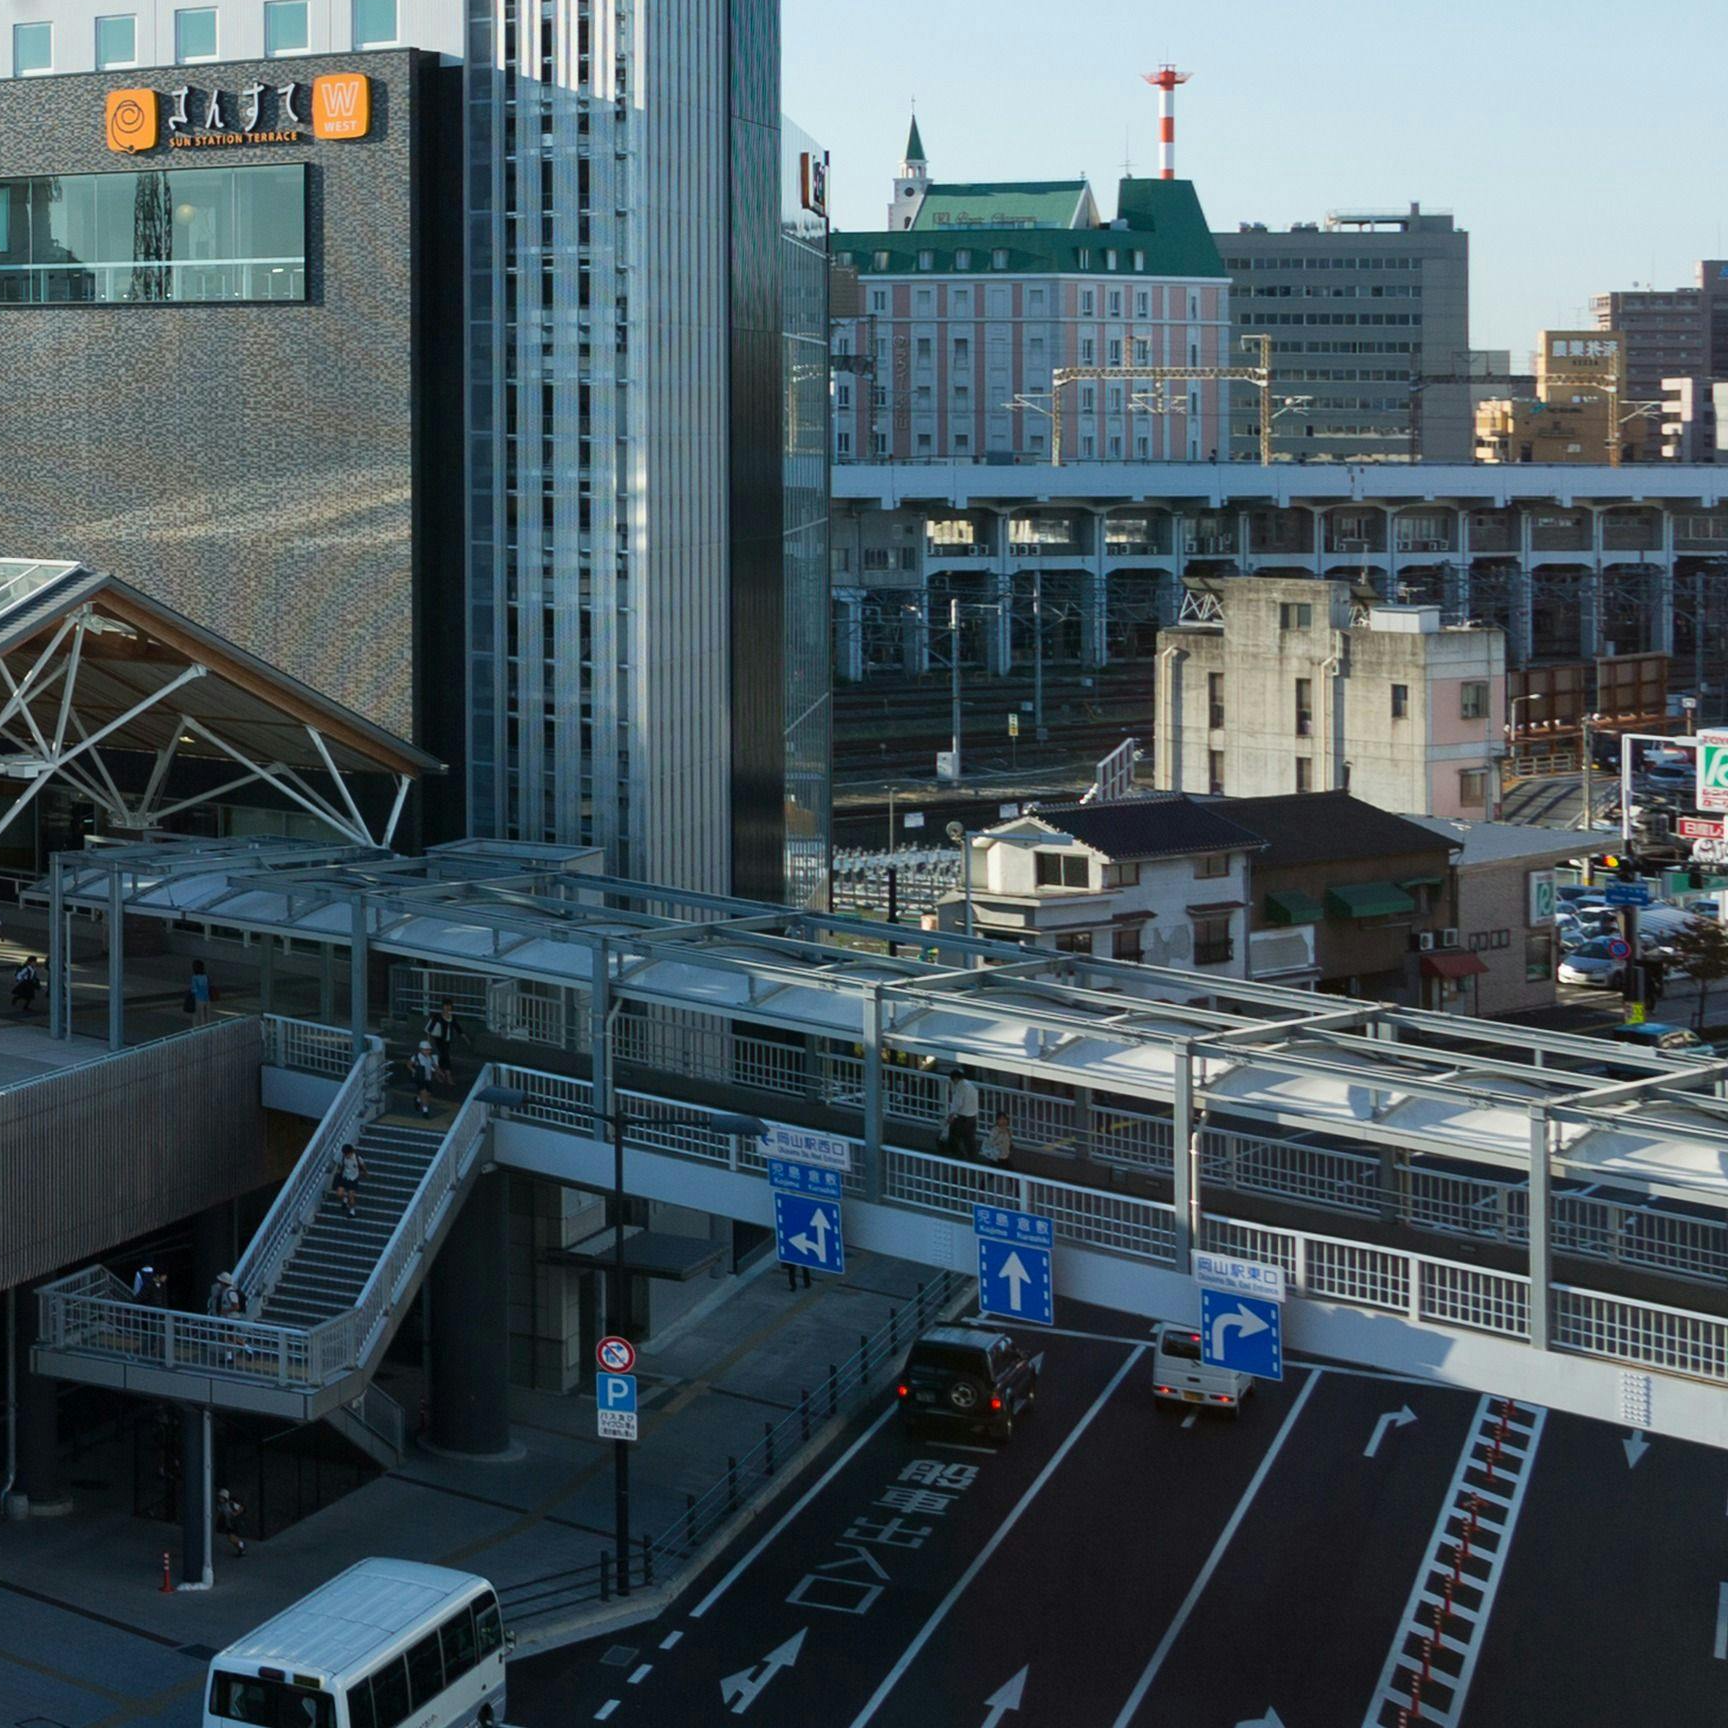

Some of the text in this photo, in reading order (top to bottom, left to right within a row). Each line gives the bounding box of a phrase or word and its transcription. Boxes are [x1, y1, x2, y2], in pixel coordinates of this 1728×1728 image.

[169, 81, 300, 131] さんすて
[169, 131, 298, 148] SUN STATION TERRACE
[324, 119, 357, 133] WEST
[777, 1131, 845, 1156] 岡山駅西口
[1198, 1256, 1278, 1285] 岡山駅東口
[607, 1377, 629, 1407] P
